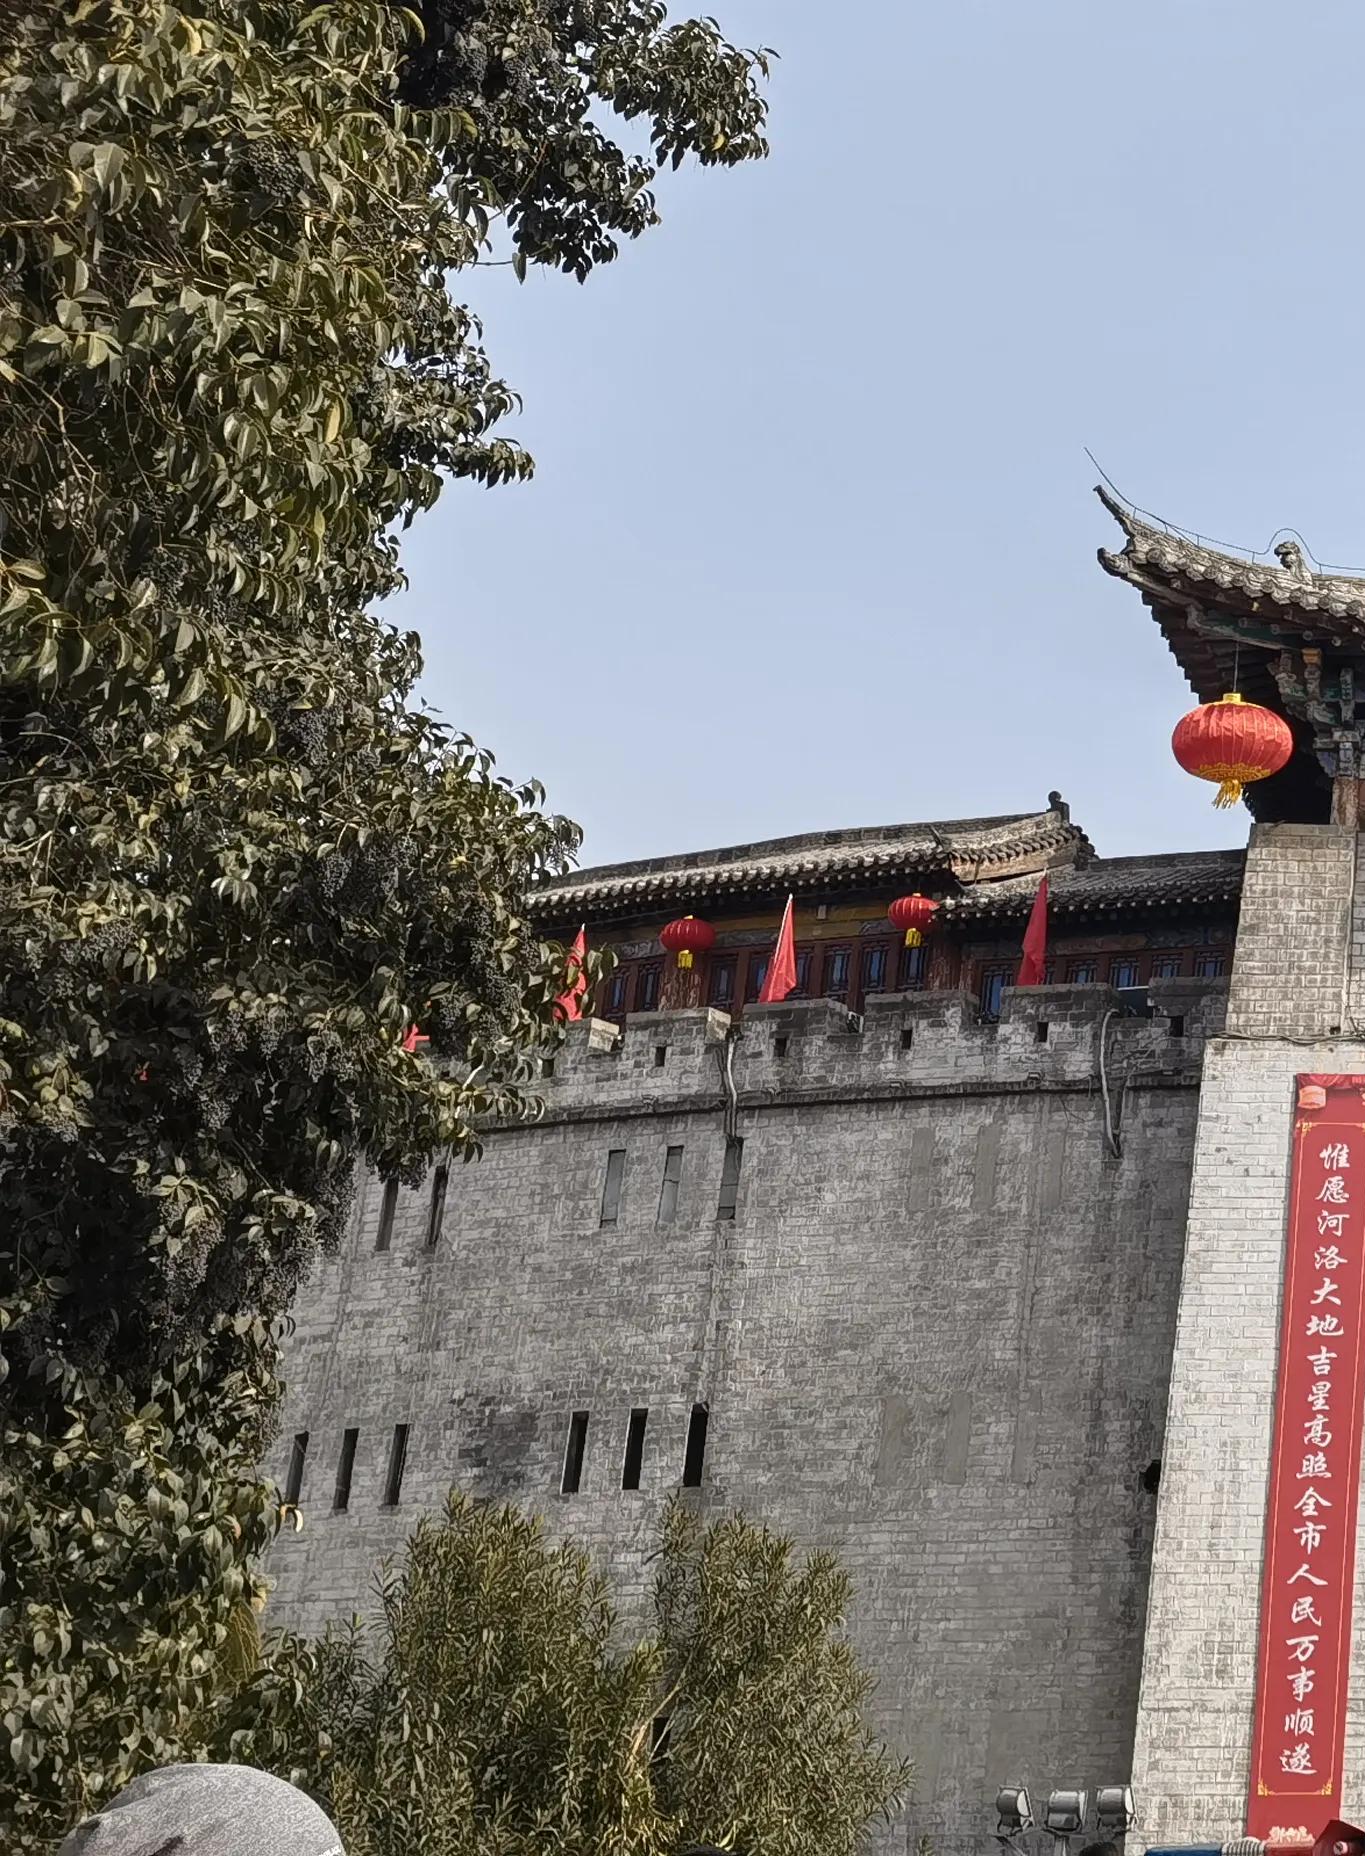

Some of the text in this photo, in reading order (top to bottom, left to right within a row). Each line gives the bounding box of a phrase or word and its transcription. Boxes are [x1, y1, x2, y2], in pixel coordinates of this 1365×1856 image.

[1280, 1143, 1350, 1774] 惟愿河洛大地吉星高照全市人民万事顺遂
